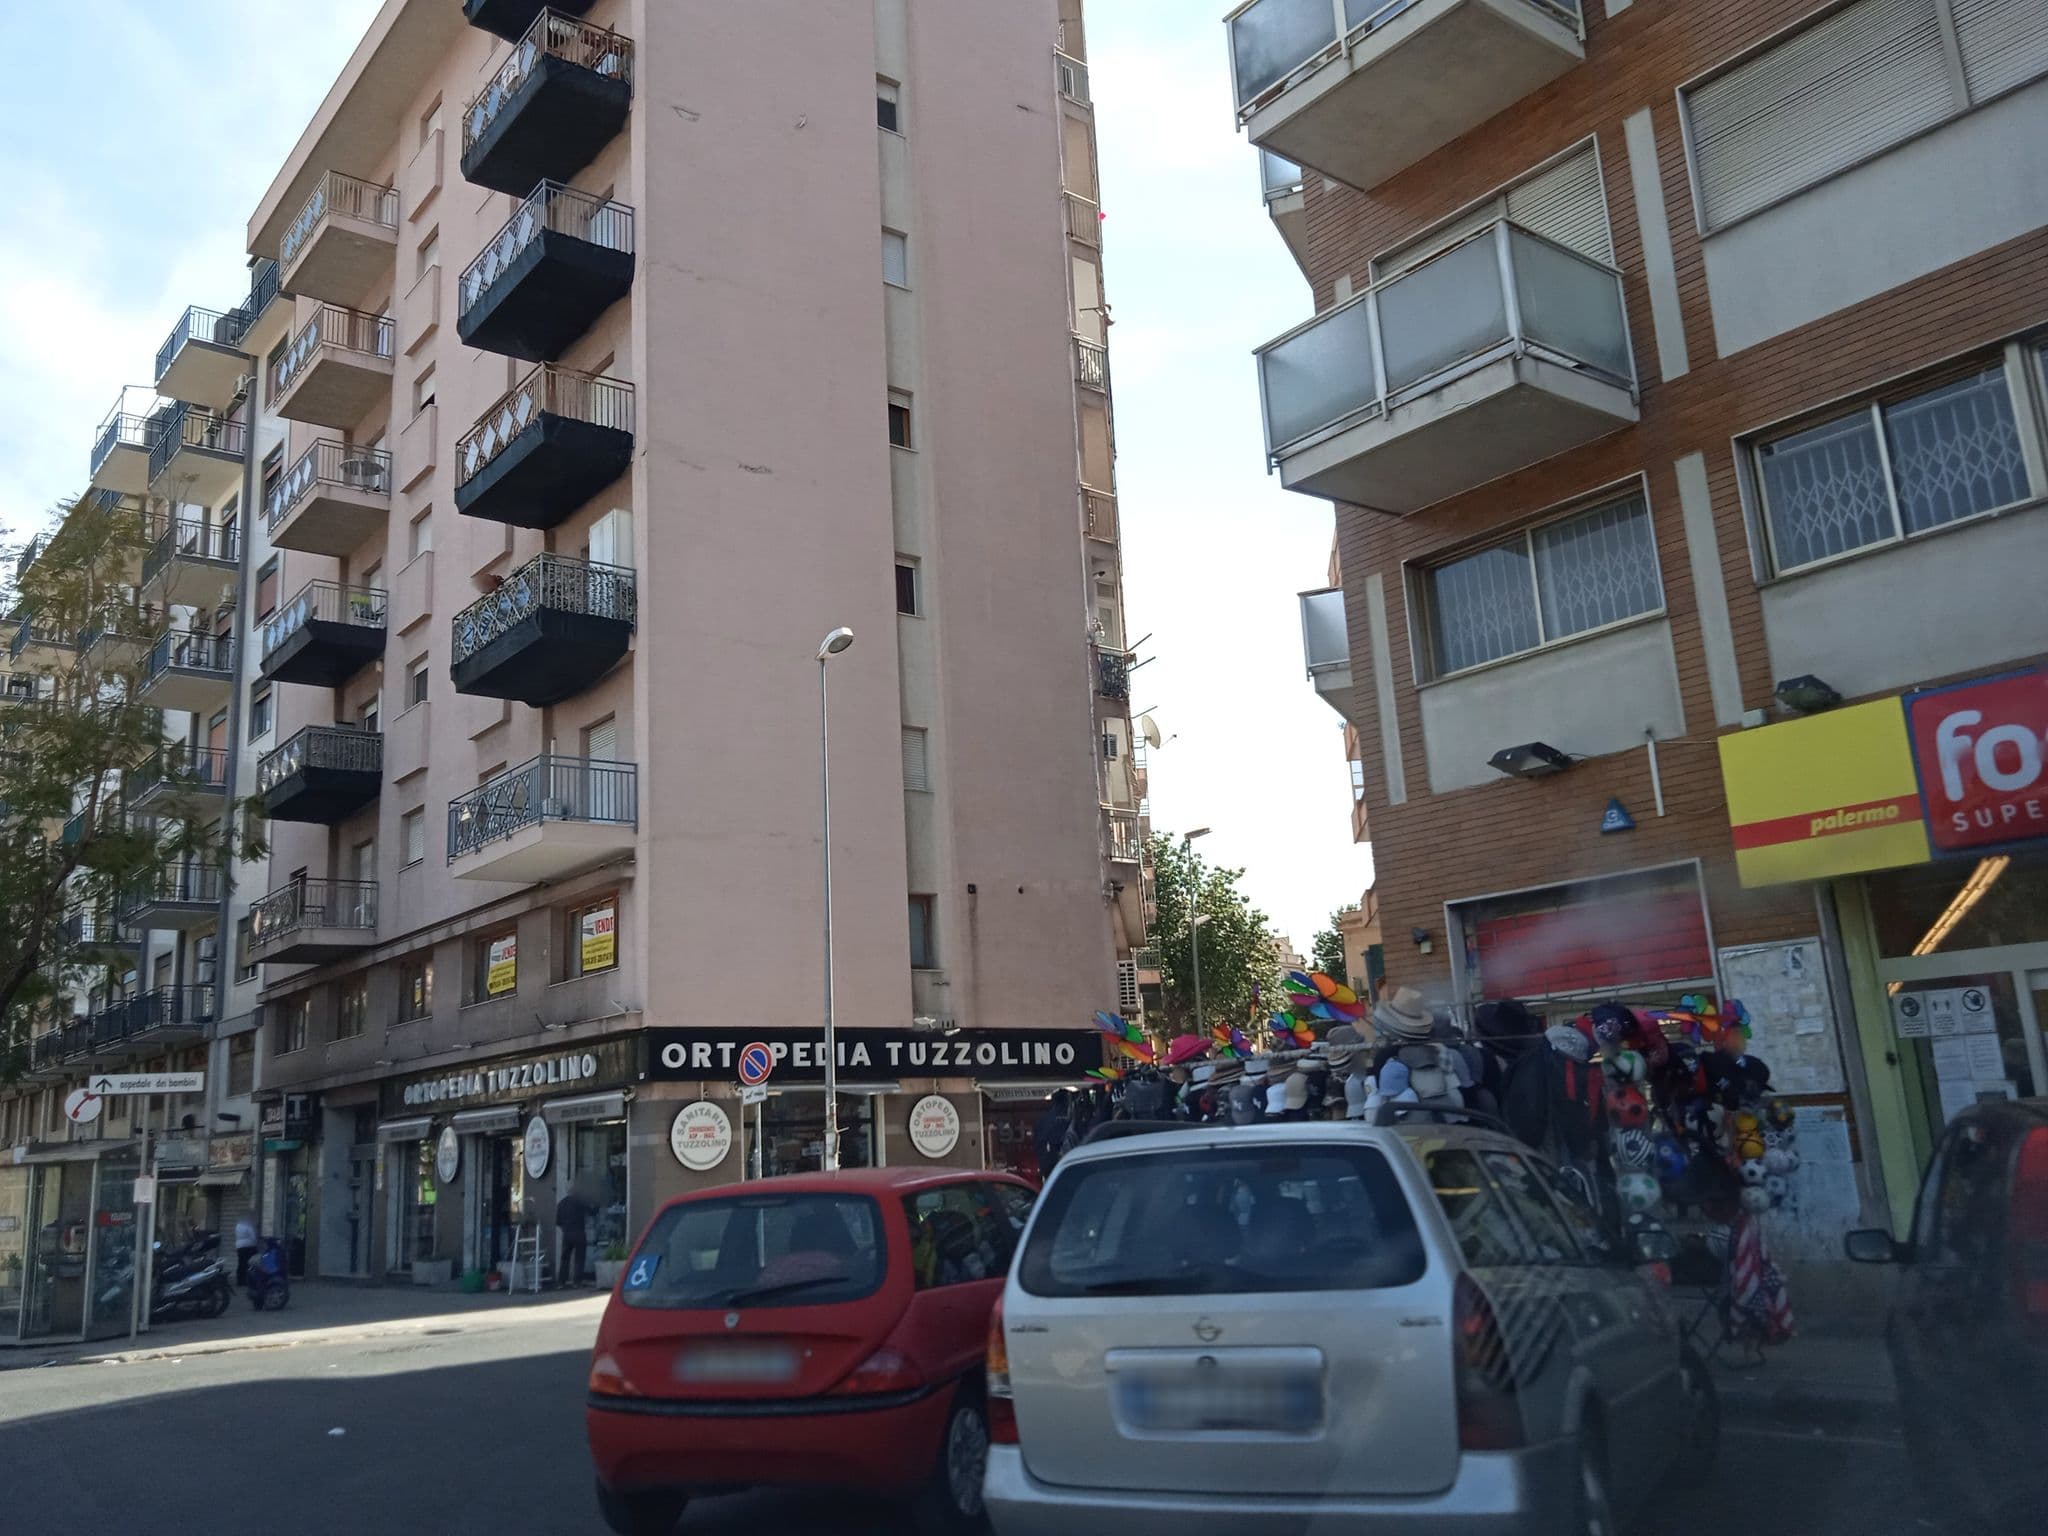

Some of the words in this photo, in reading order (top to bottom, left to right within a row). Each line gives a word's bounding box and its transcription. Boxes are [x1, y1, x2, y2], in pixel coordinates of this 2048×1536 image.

[1936, 710, 2048, 802] fo
[1811, 805, 1899, 836] palermo
[1952, 800, 2044, 832] SUPE
[661, 1042, 872, 1069] ORTPEDIA
[885, 1042, 1075, 1066] TUZZOLINO
[120, 1079, 151, 1090] ospedale
[156, 1079, 167, 1088] dei
[168, 1077, 198, 1088] bambini
[404, 1073, 486, 1106] ORTOPEDIA
[487, 1053, 597, 1095] TUZZOLINO
[677, 1107, 726, 1135] SANITARIA
[914, 1101, 954, 1126] ORTOPEDIA
[677, 1139, 727, 1149] TUZZOLINO
[914, 1128, 955, 1138] TUZZOLINO
